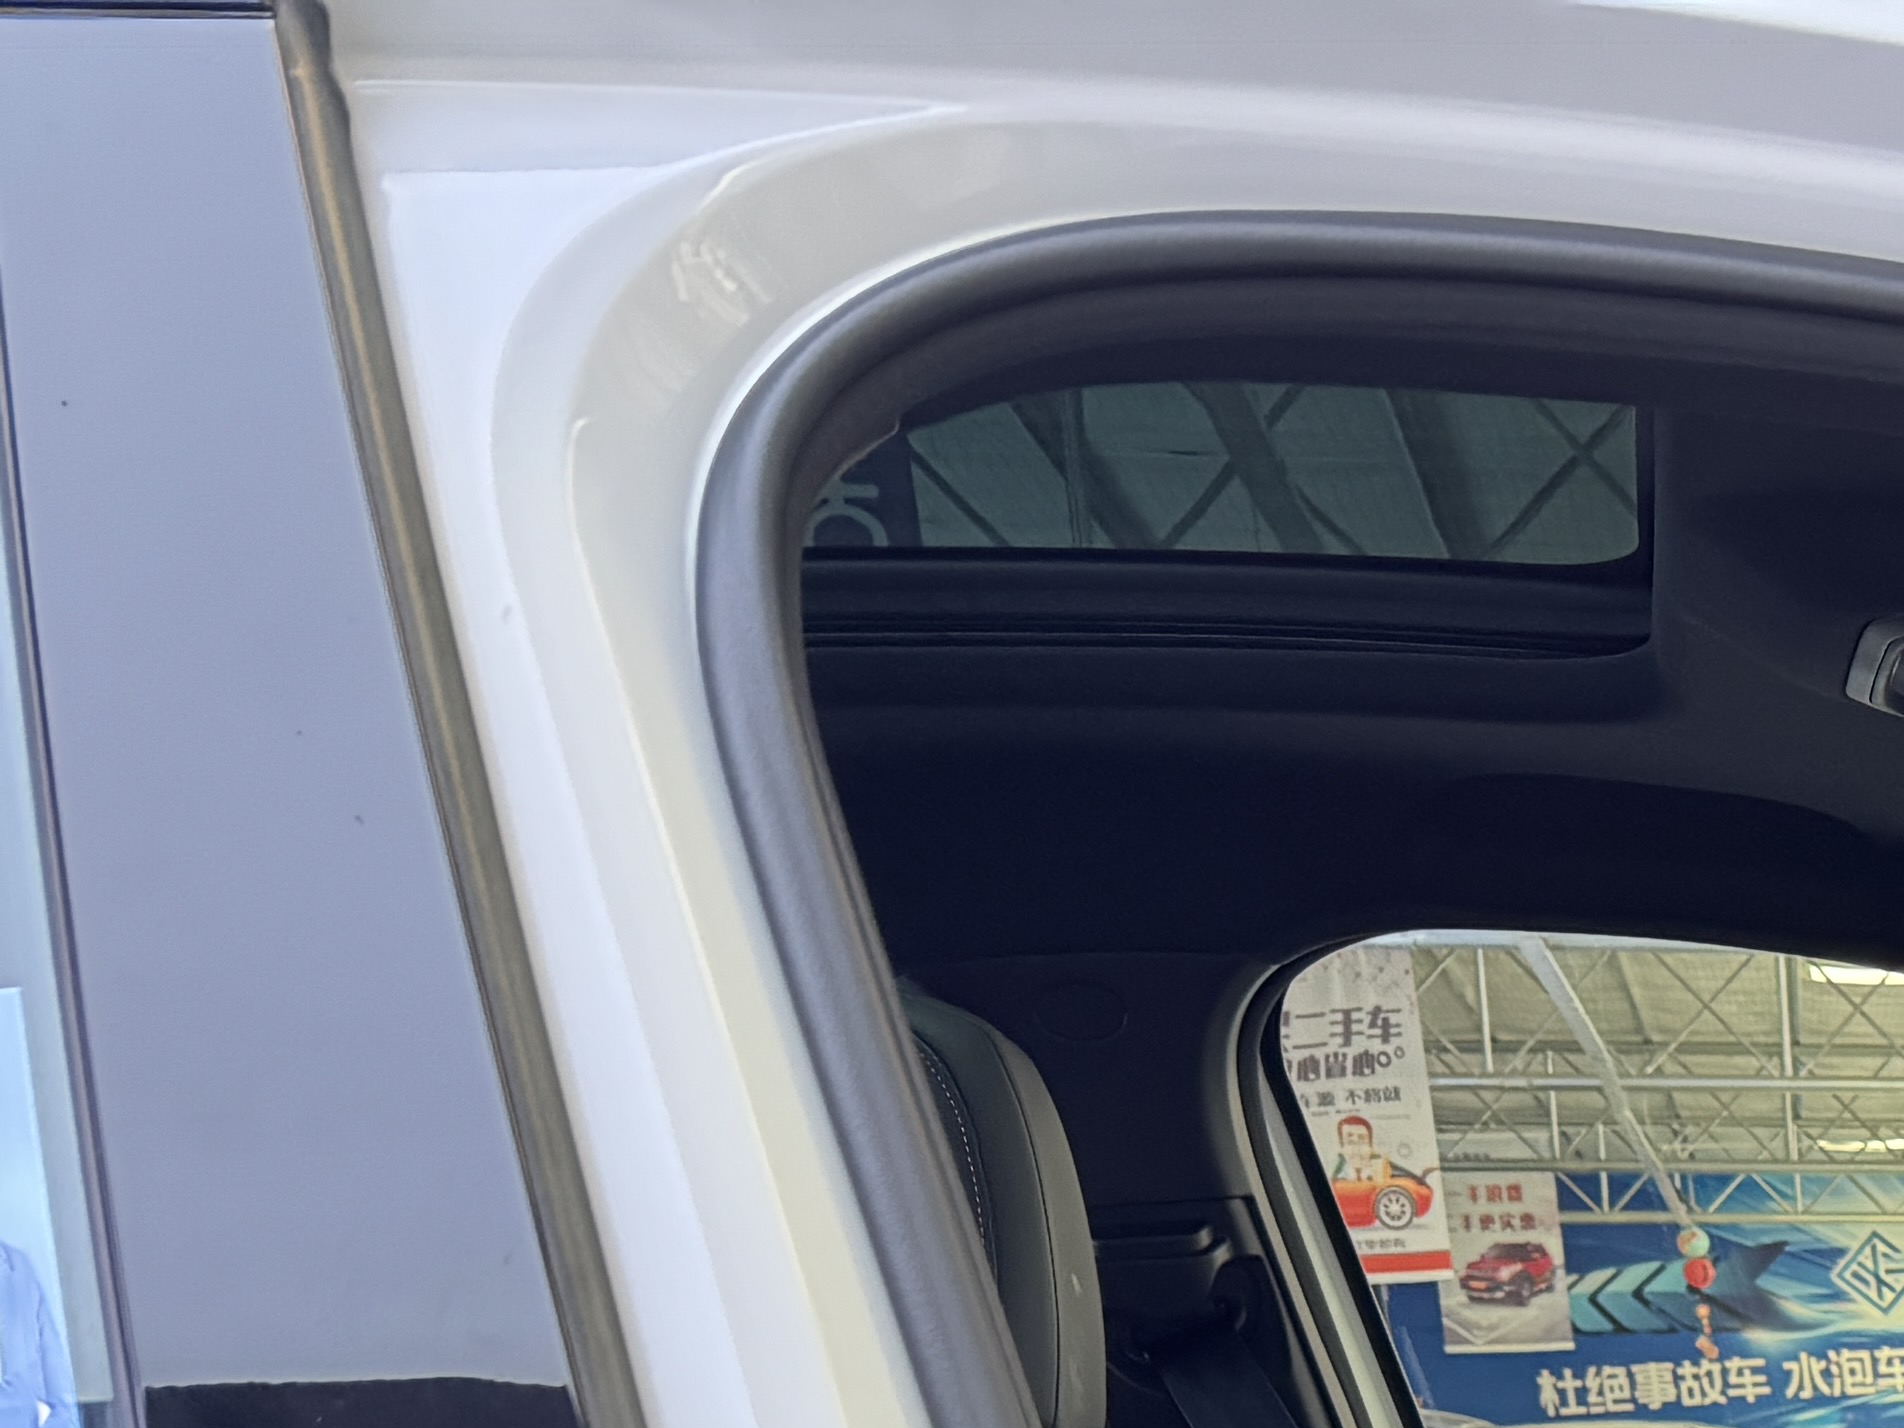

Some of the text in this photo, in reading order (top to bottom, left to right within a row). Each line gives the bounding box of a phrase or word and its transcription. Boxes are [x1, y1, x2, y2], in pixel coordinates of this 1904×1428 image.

[1281, 1005, 1402, 1050] 二手车
[1536, 1356, 1771, 1417] 杜绝事故车
